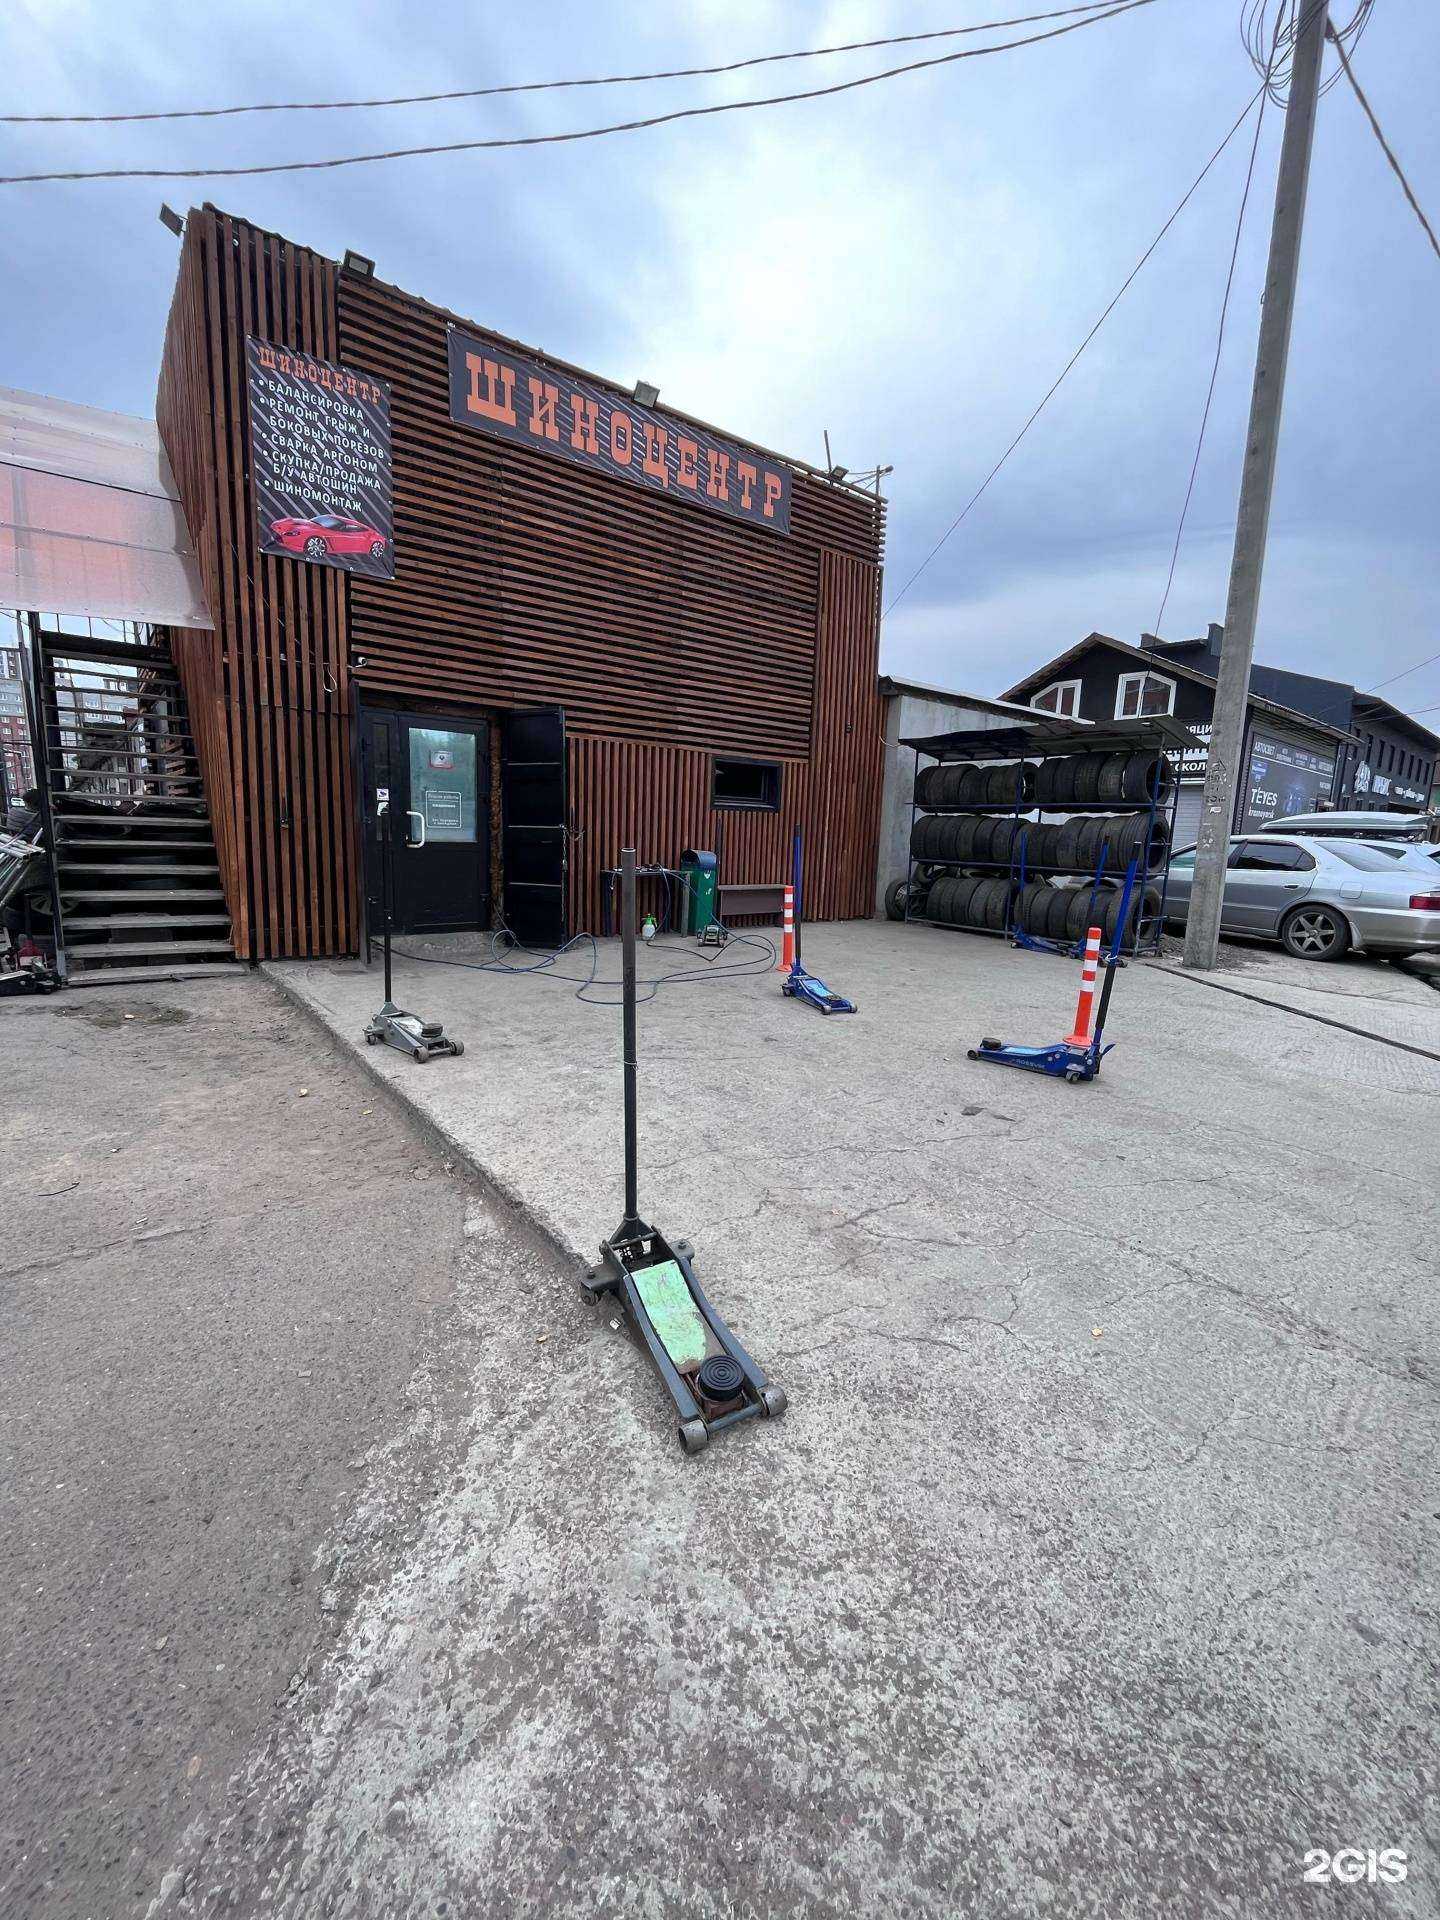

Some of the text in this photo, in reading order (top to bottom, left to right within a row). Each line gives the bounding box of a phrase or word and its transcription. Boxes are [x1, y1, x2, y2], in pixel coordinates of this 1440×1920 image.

[258, 346, 381, 404] ШИНОЦЕНТР
[268, 380, 364, 420] БАЛАНСИРОВКА
[269, 397, 370, 438] РЕМОНТ ГРЫЖ И
[270, 416, 384, 459] БОКОВЫХ ПОРЕЗОВ
[271, 433, 378, 473] СВАРКА АРГОНОМ
[465, 351, 783, 518] ШИНОЦЕНТР
[272, 450, 381, 490] СКУПКА/ПРОДАЖА
[273, 463, 357, 494] Б/У АВТОШИН
[273, 480, 362, 512] ШИНОМОНТАЖ
